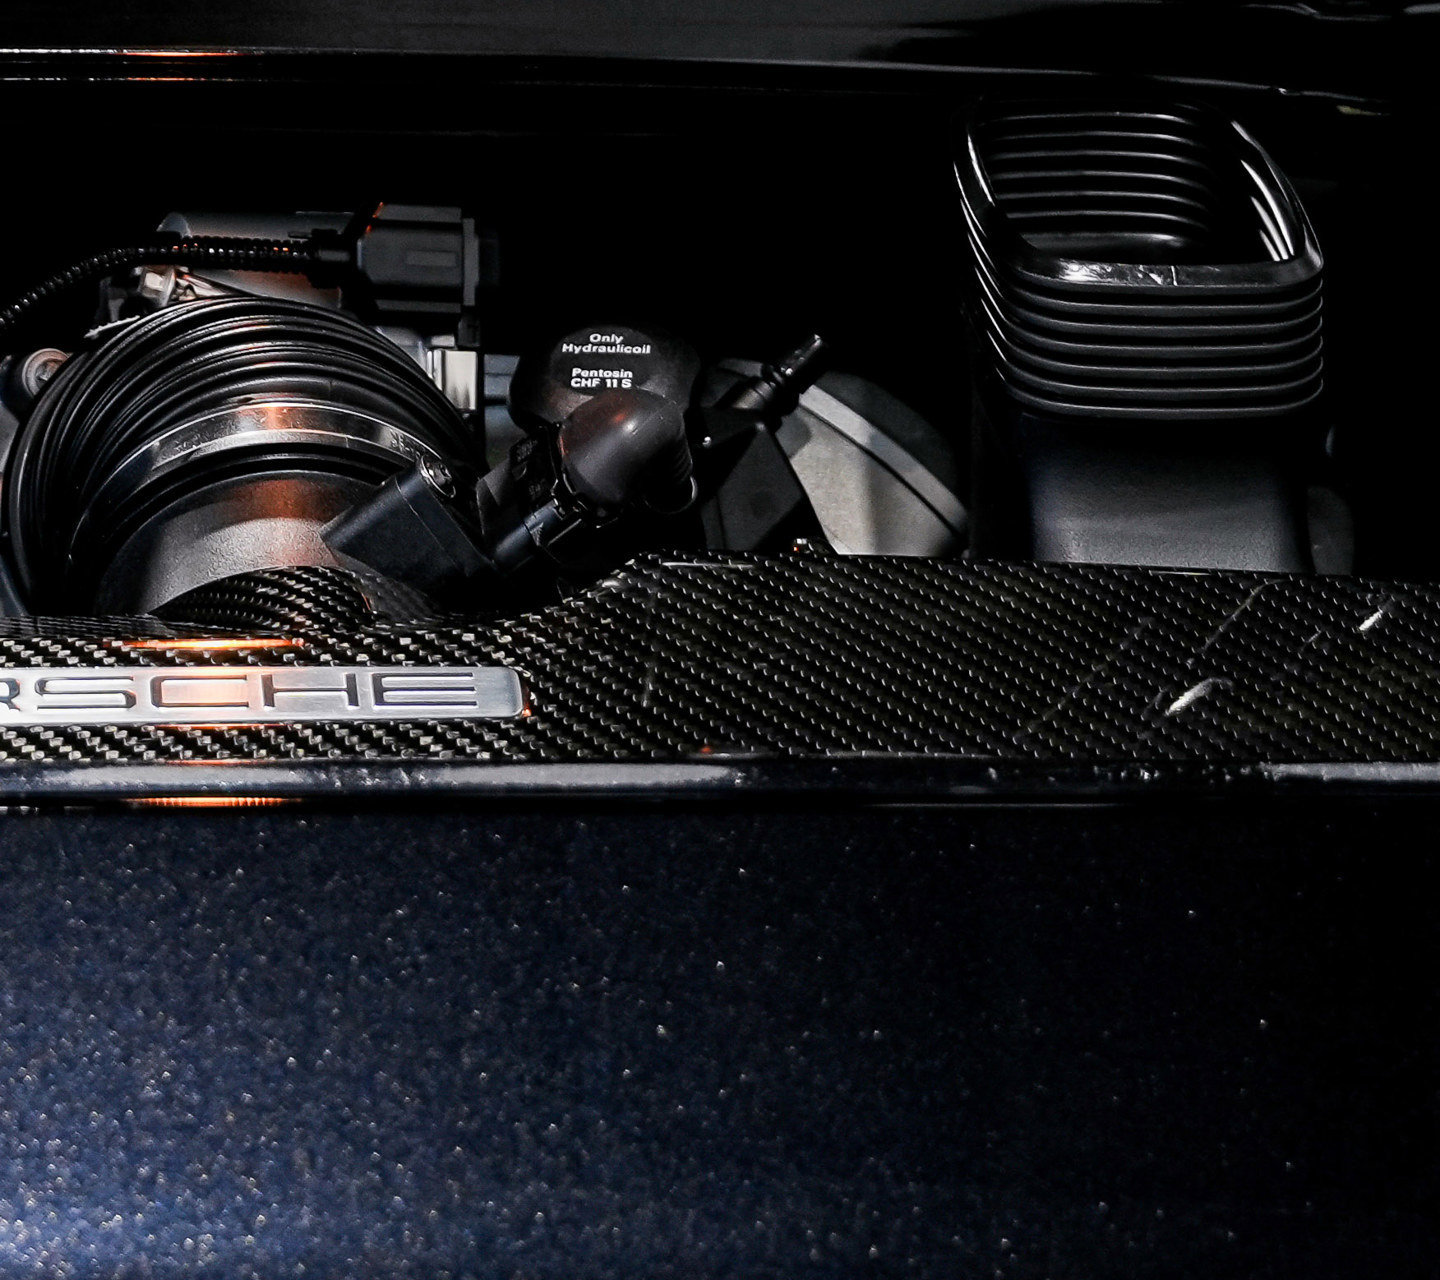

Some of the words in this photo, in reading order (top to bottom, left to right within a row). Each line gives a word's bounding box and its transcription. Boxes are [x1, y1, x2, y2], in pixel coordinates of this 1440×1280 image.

[590, 334, 623, 344] Only
[562, 344, 650, 353] Hydraulicoil
[572, 368, 632, 378] Pentosin
[571, 378, 600, 387] CHF
[606, 379, 617, 387] 11
[622, 379, 631, 388] S
